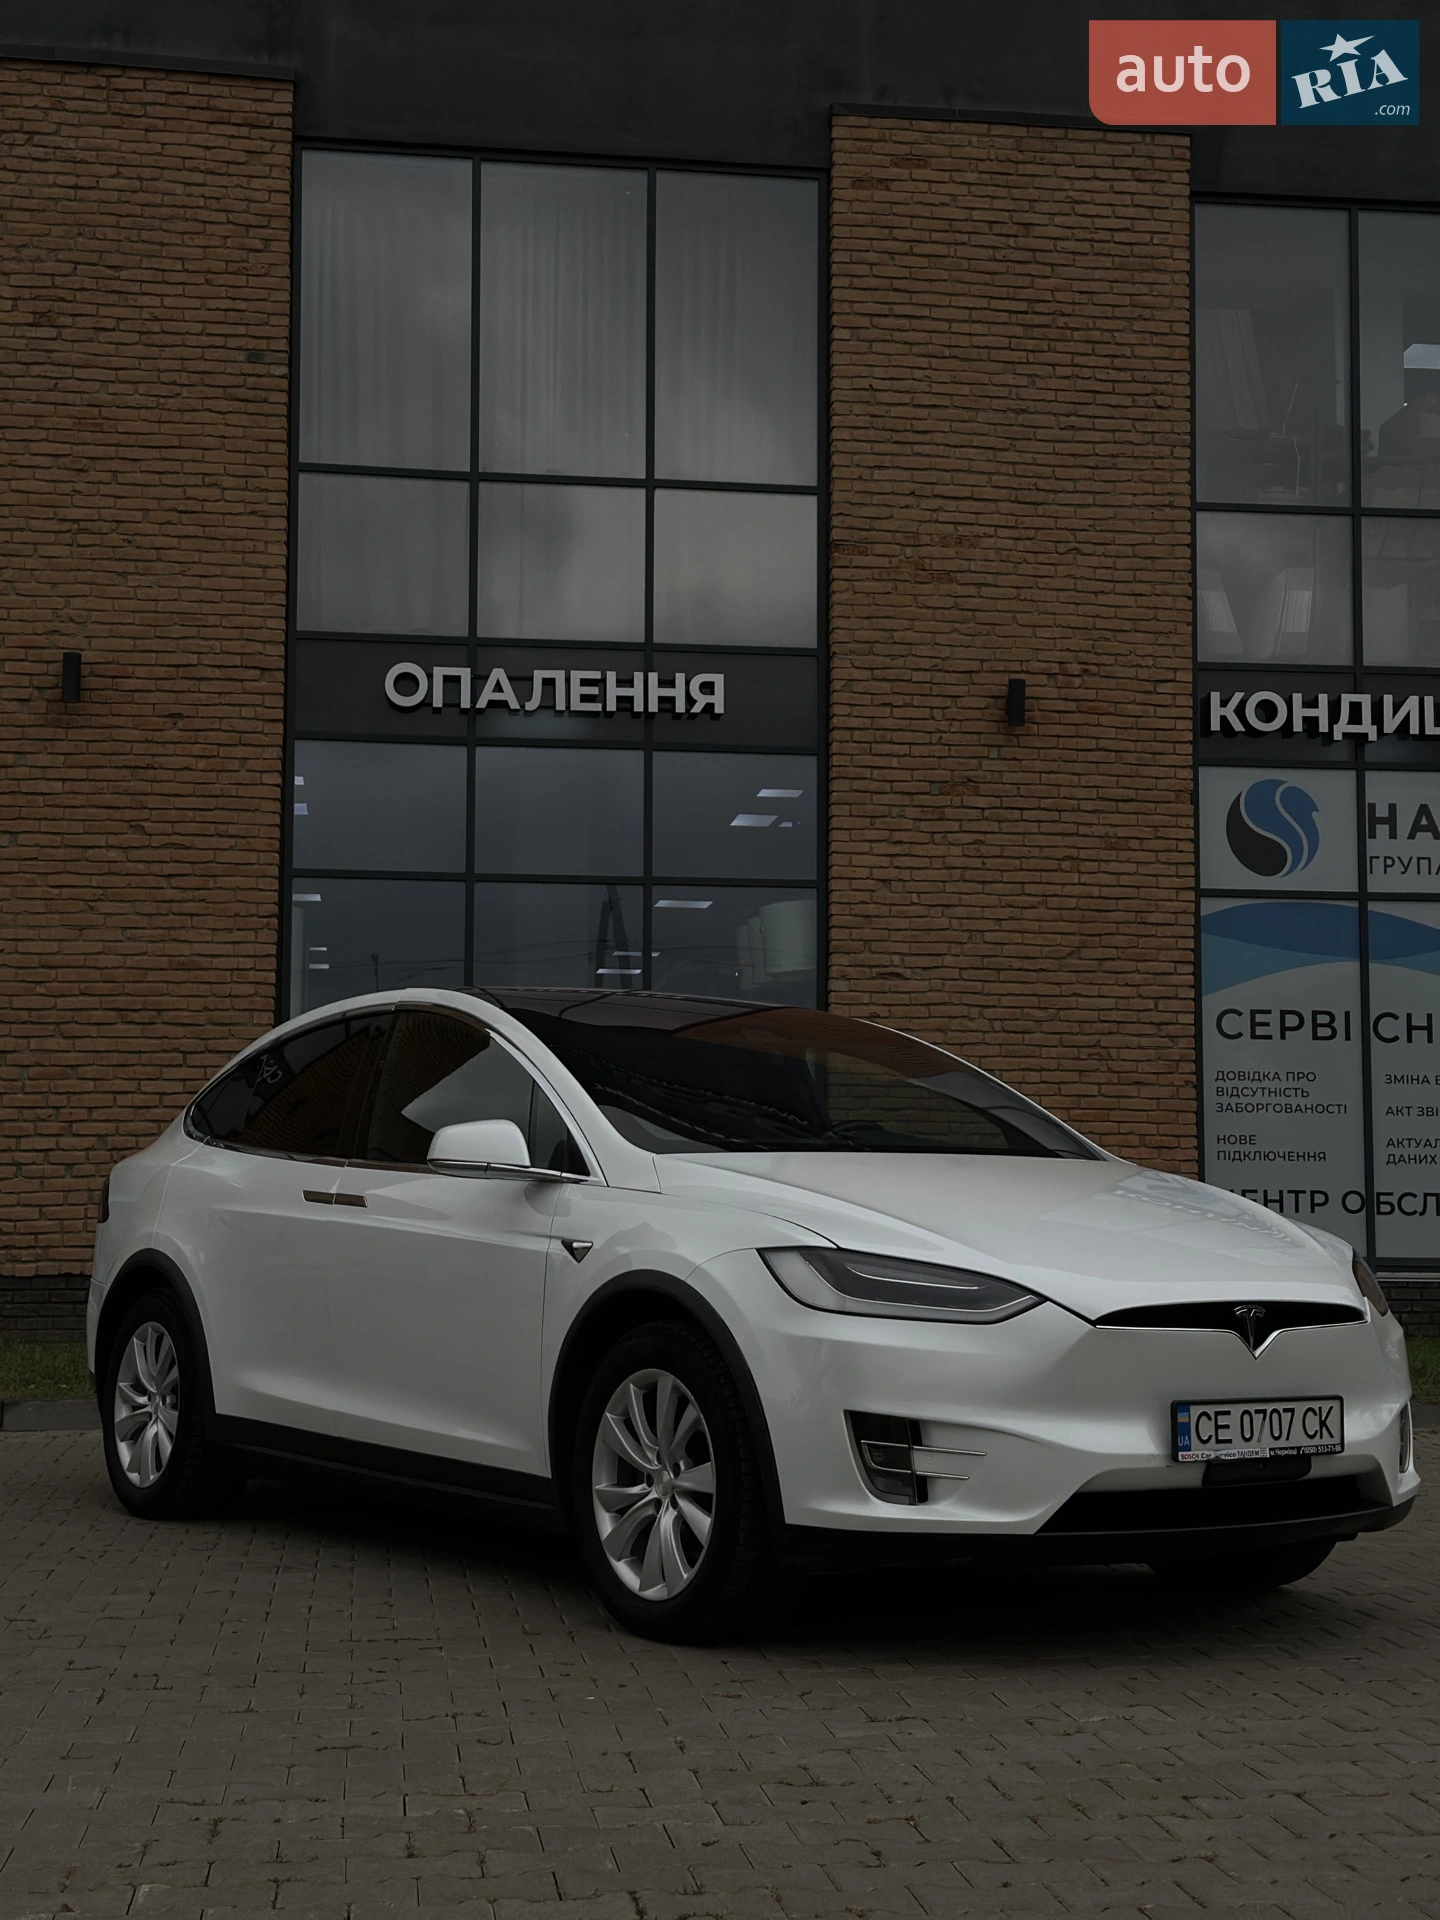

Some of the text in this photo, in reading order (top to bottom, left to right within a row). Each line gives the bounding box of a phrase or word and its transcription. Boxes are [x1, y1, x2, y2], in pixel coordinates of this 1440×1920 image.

[384, 661, 725, 715] ОПАЛЕННЯ
[1367, 802, 1440, 840] НА
[1369, 855, 1440, 876] ГРУП
[1215, 1070, 1317, 1083] ДОВІДКА ПРО
[1384, 1074, 1431, 1085] ЗМІНА
[1216, 1086, 1310, 1099] ВІДСУТНІСТЬ
[1215, 1102, 1348, 1115] ЗАБОРГОВАНОСТІ
[1385, 1106, 1412, 1117] АКТ
[1216, 1134, 1257, 1145] НОВЕ
[1217, 1150, 1327, 1163] ПІДКЛЮЧЕННЯ
[1386, 1154, 1438, 1167] ДАНИХ
[1195, 1405, 1334, 1445] CE 0707 CK
[1178, 1435, 1190, 1446] UA
